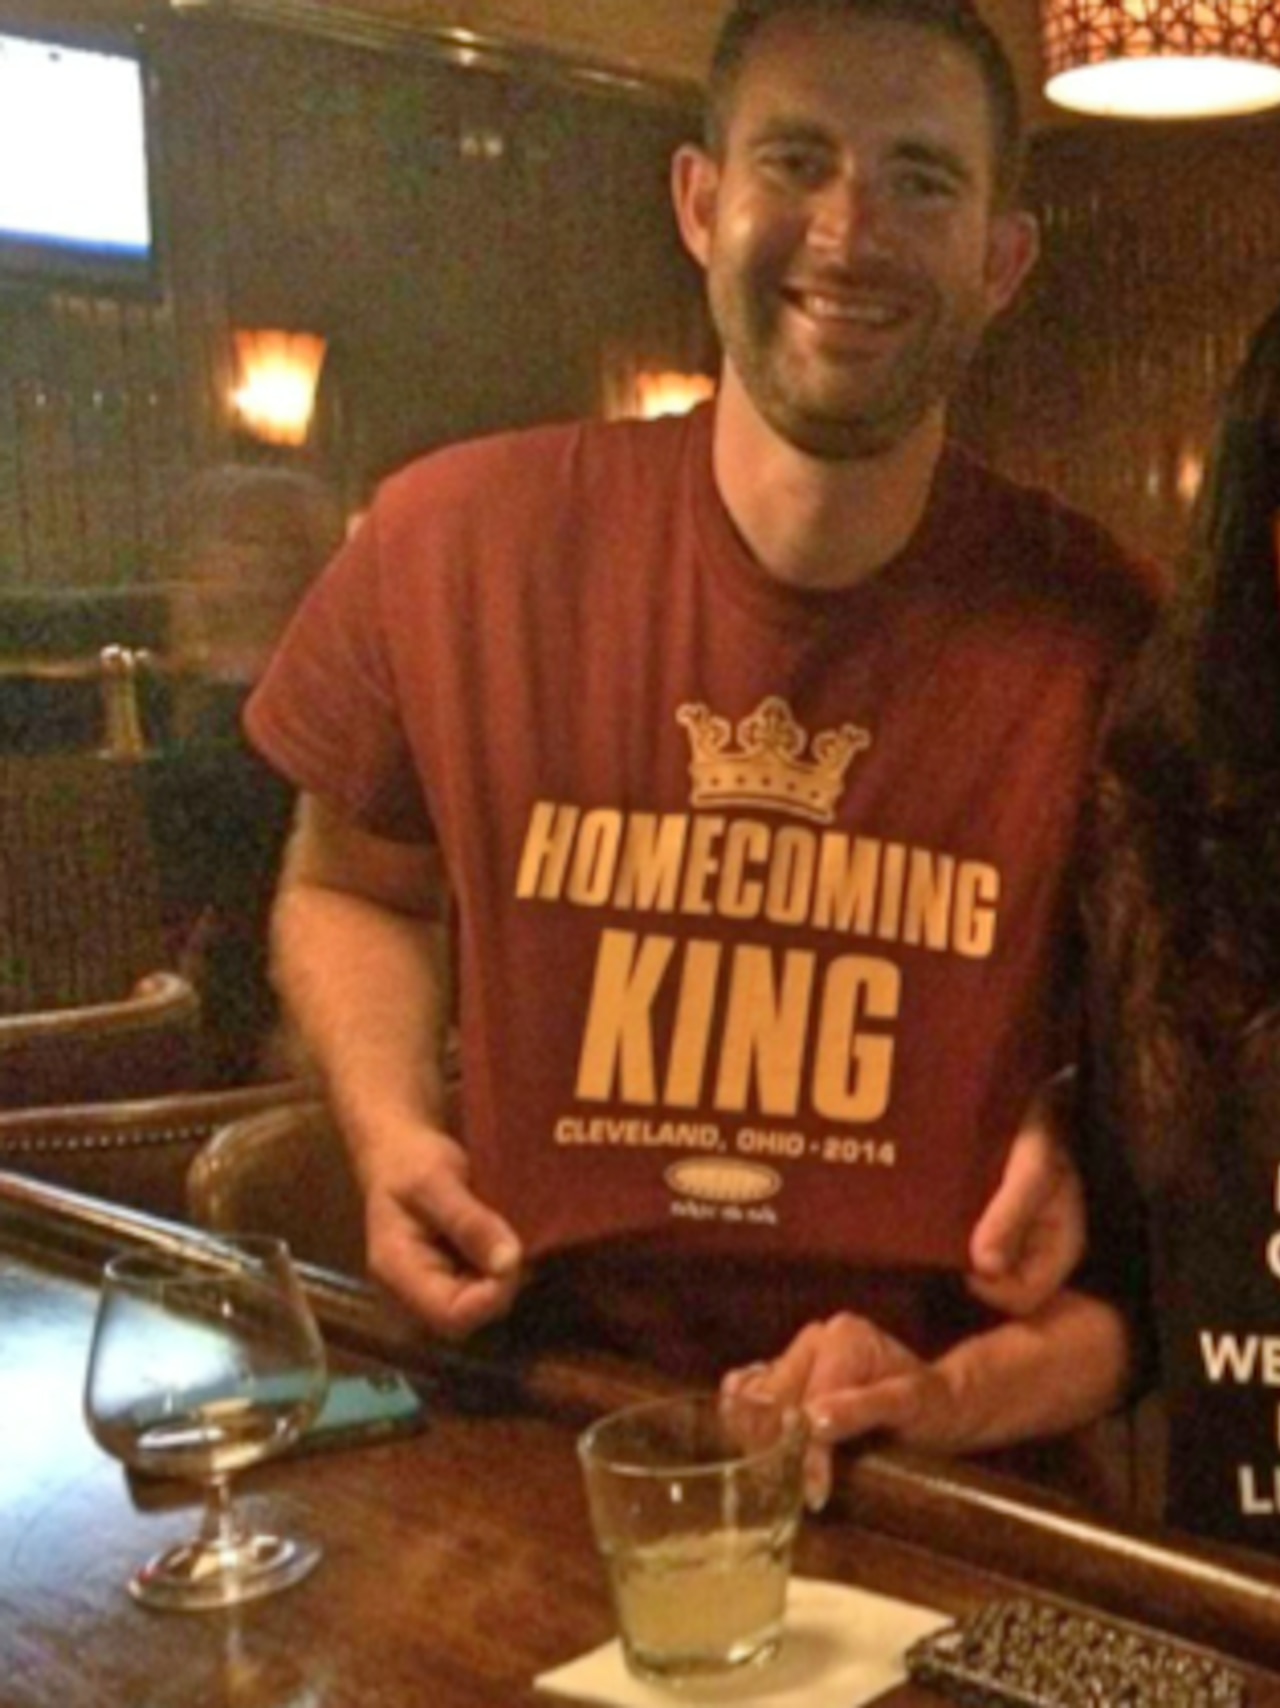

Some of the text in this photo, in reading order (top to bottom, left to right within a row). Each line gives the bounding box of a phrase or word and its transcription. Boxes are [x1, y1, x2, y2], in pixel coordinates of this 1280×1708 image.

[516, 801, 999, 959] HOMECOMING
[575, 928, 900, 1123] KING
[554, 1118, 727, 1151] CLEVELAND,
